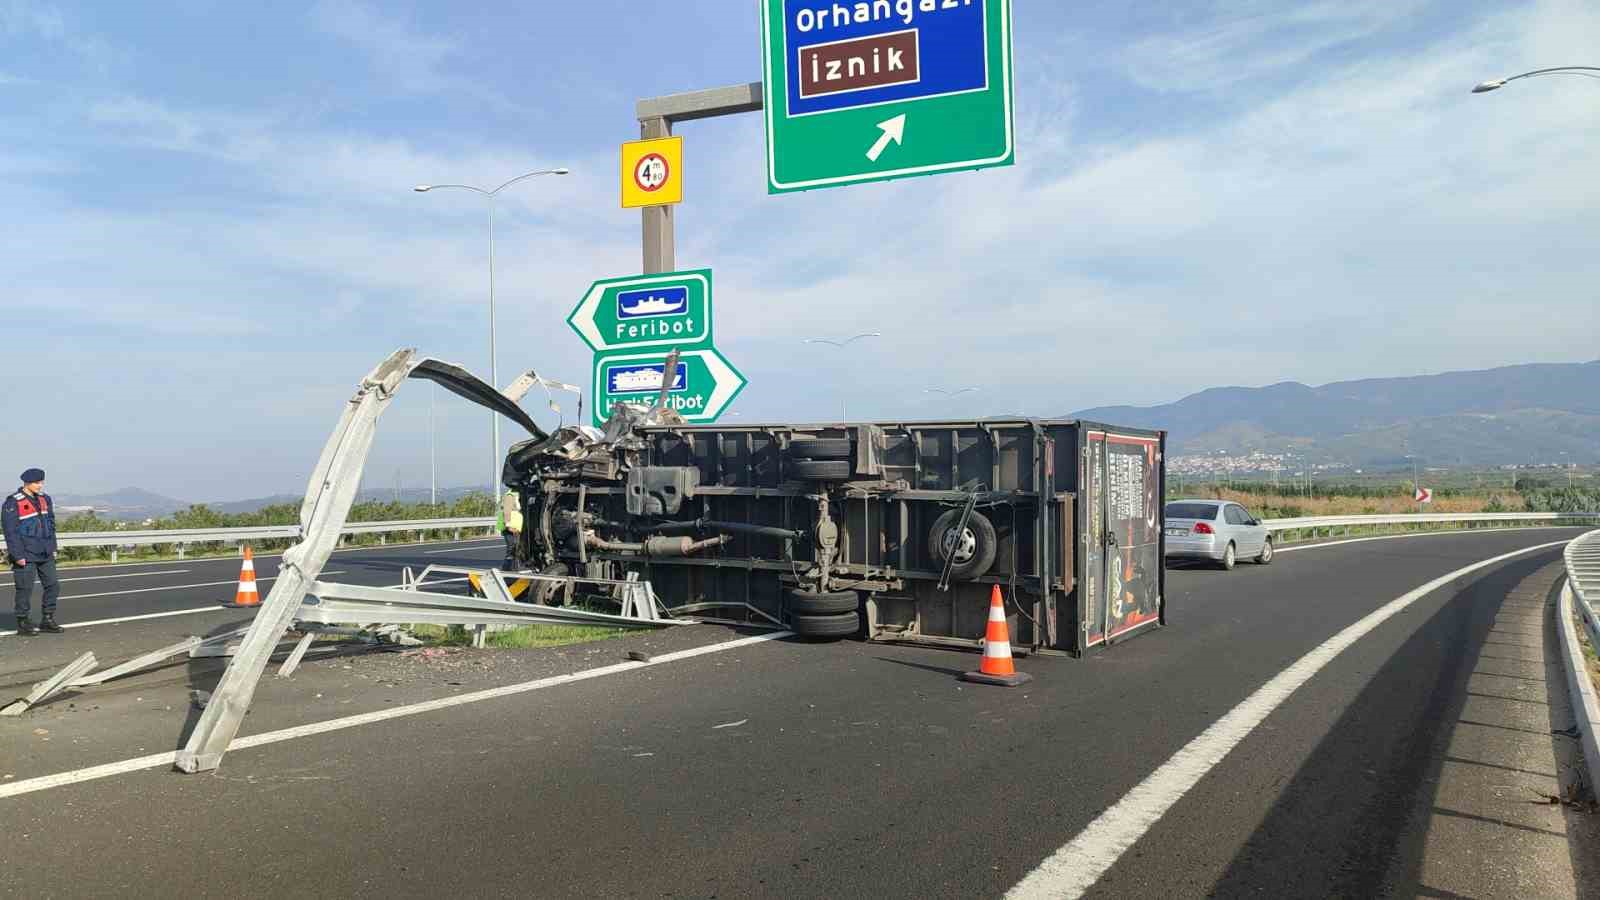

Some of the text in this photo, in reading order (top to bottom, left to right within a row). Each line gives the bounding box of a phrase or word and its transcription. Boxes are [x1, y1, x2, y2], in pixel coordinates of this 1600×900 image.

[796, 0, 972, 32] Orhanga
[811, 47, 905, 83] İznik
[642, 164, 651, 182] 4
[616, 318, 694, 339] Feribot
